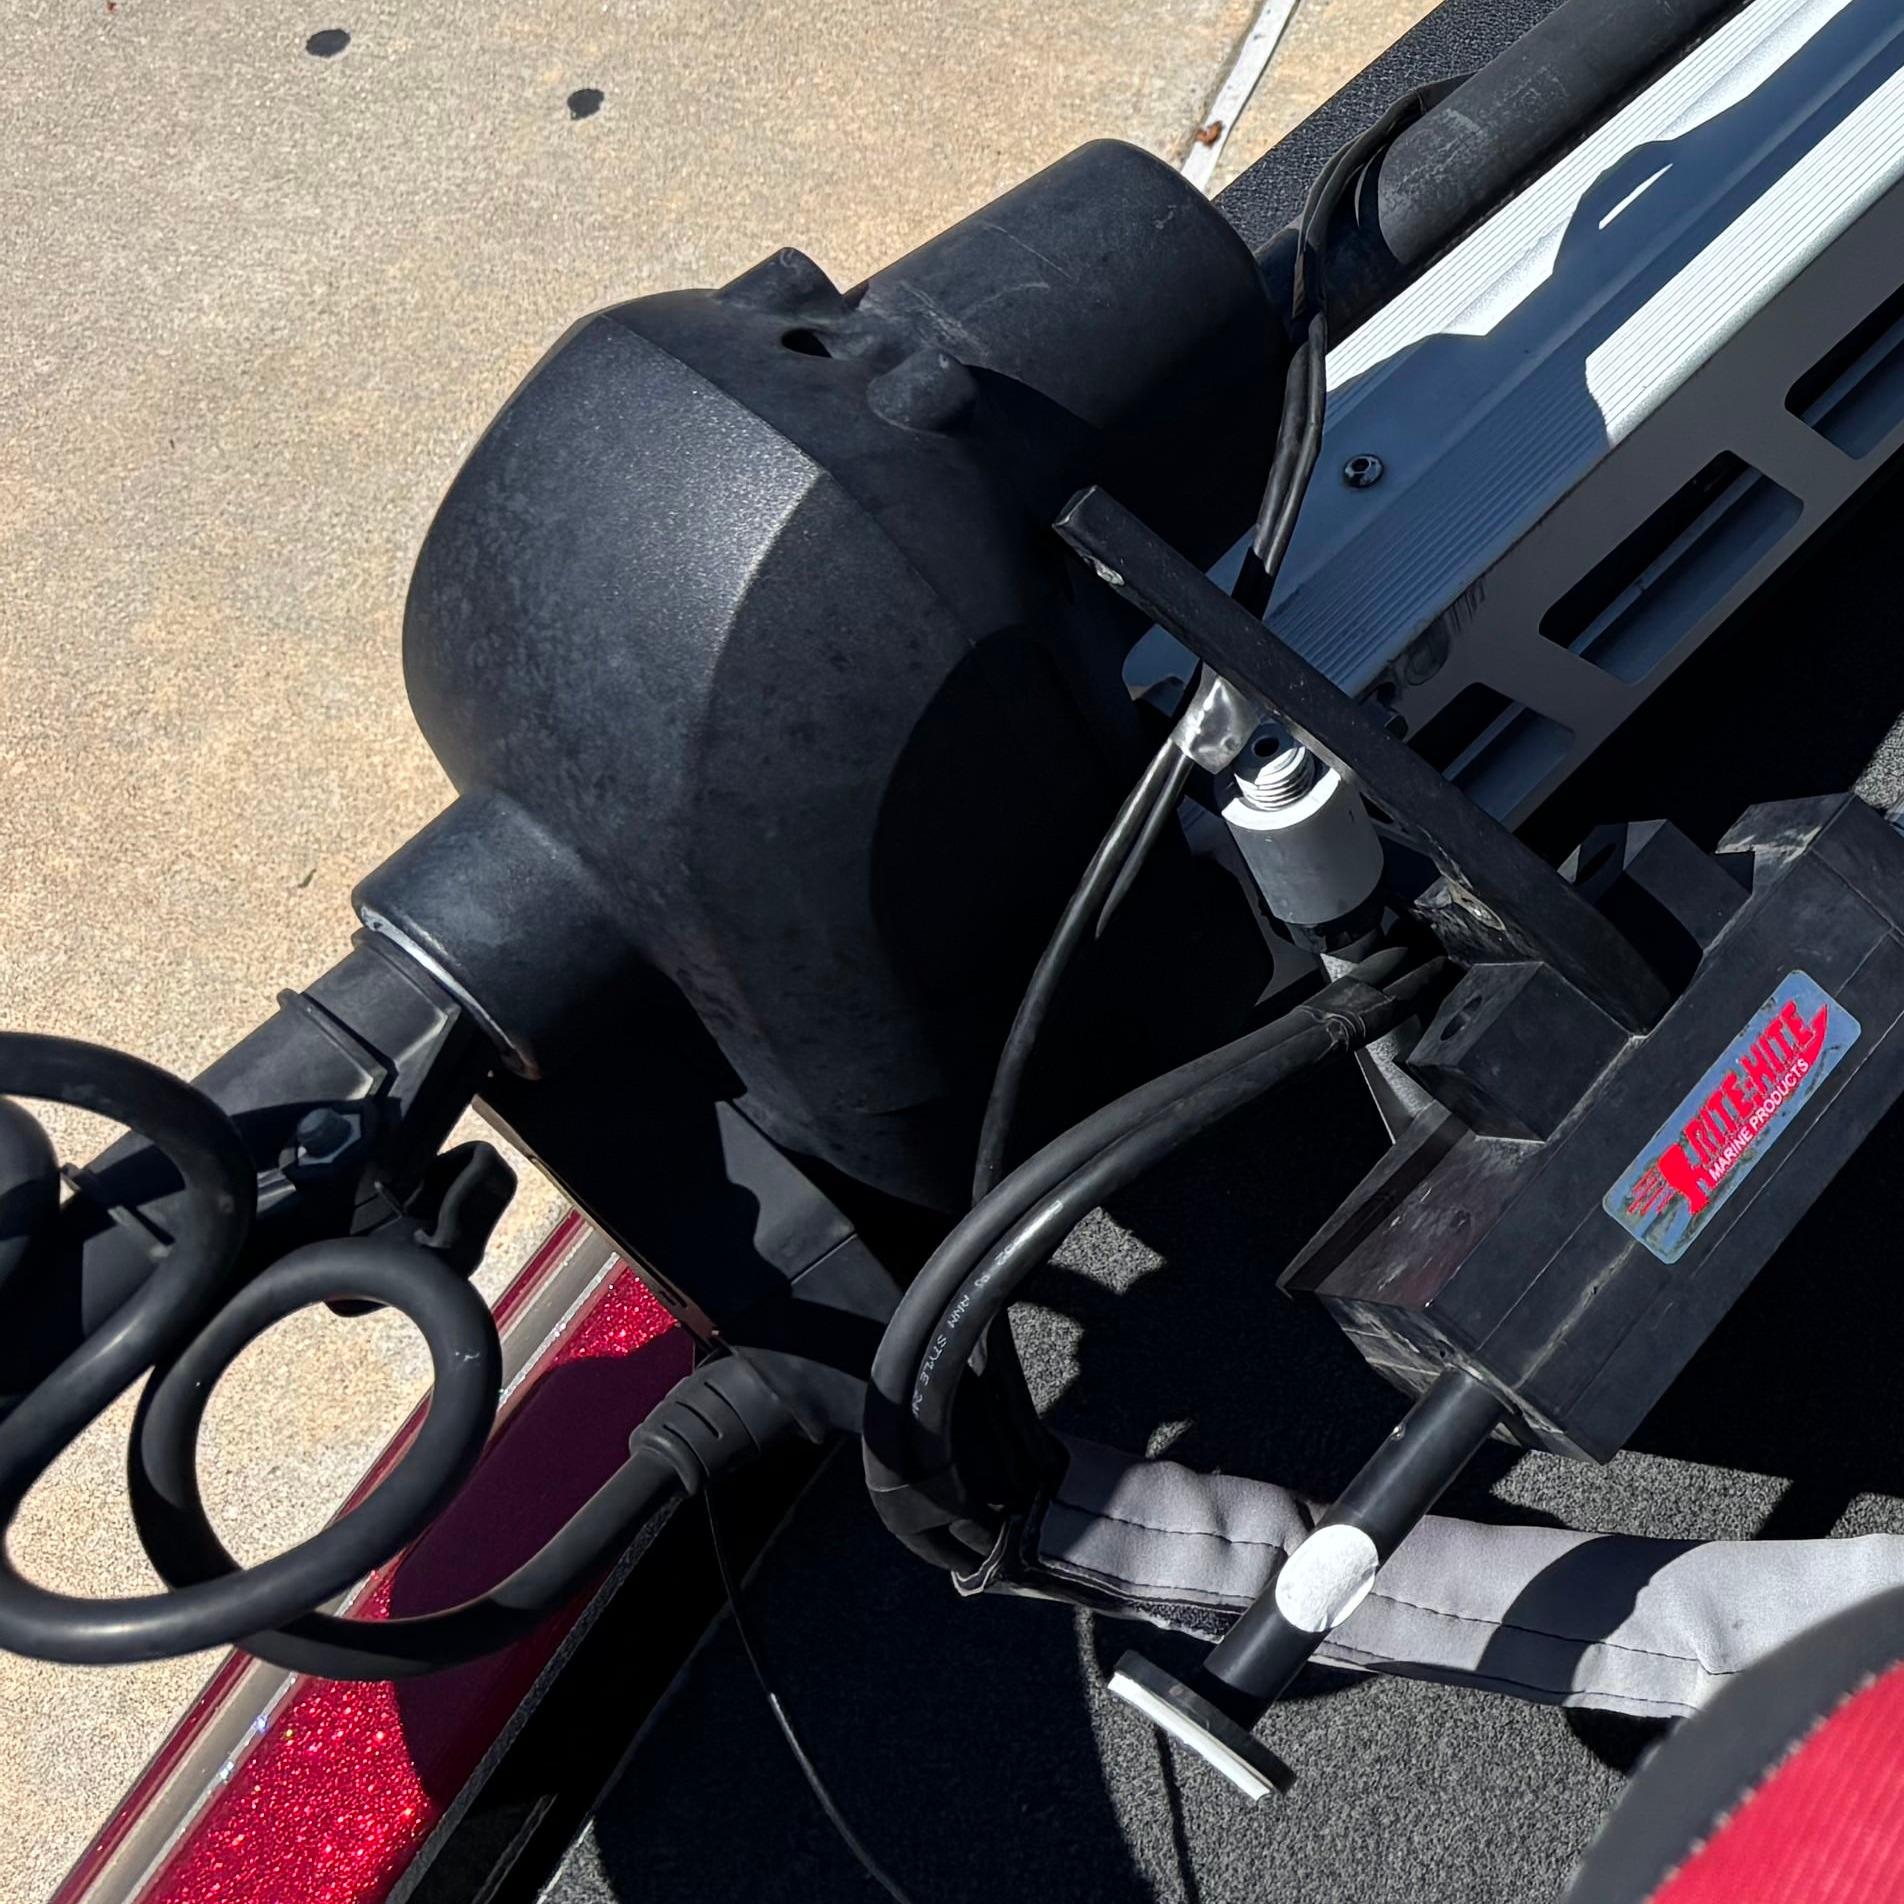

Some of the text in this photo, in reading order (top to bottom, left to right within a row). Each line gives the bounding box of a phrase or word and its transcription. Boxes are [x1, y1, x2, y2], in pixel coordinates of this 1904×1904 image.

[1708, 1058, 1809, 1182] MARINE PRODUCTS
[921, 1334, 947, 1384] STYLE
